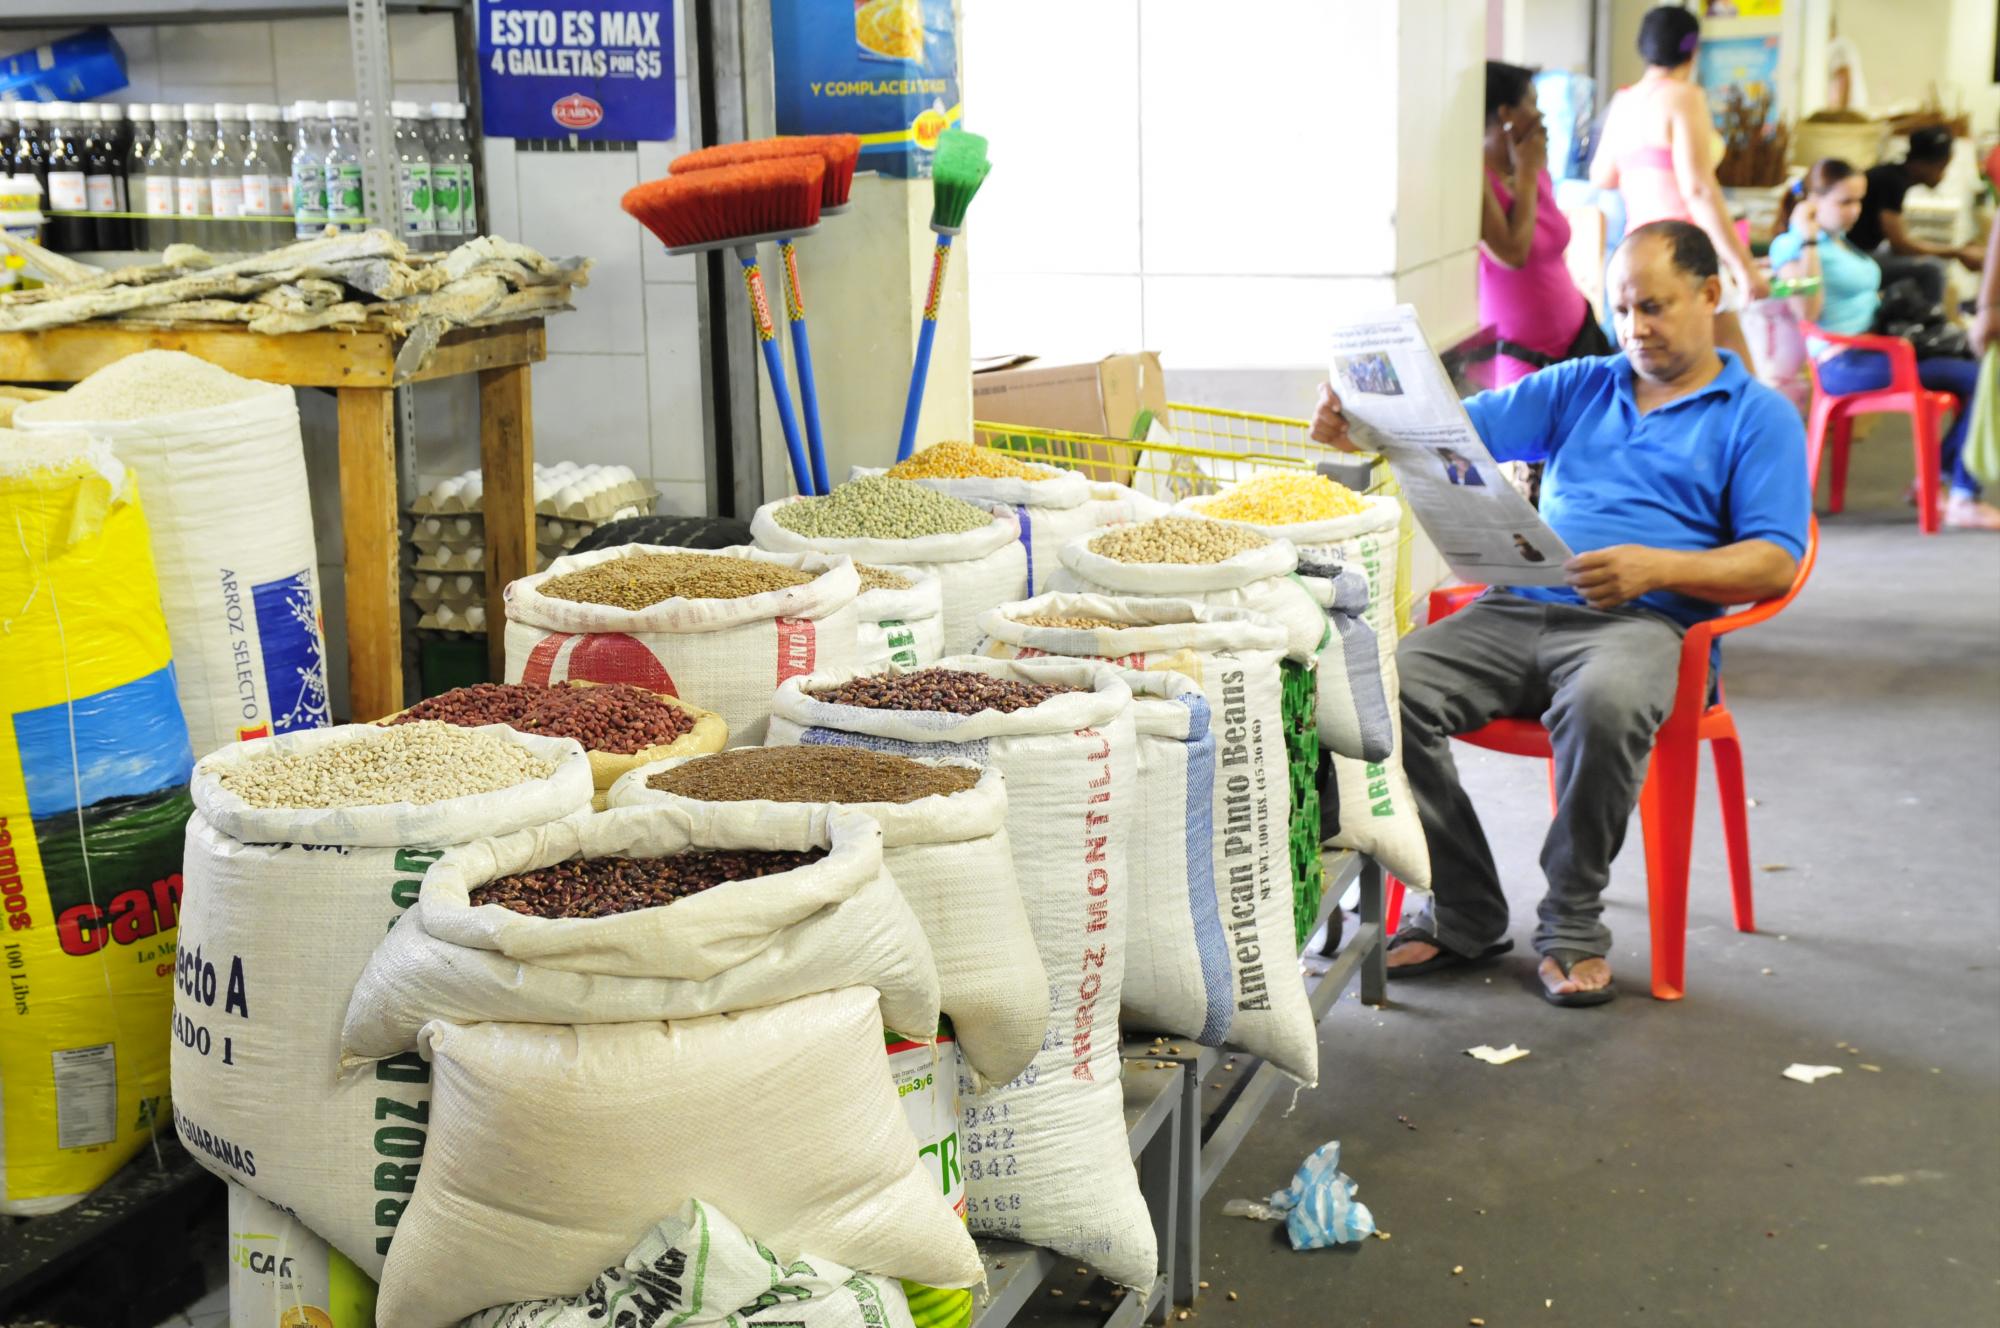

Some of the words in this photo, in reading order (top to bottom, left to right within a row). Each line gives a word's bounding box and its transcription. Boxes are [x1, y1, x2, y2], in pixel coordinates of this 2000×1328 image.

[490, 9, 557, 46] ESTO
[562, 11, 596, 47] ES
[600, 11, 661, 47] MAX
[491, 48, 505, 75] 4
[507, 49, 607, 78] GALLETAS
[610, 56, 634, 72] POR
[636, 48, 662, 80] $5
[811, 82, 822, 97] Y
[825, 79, 908, 97] COMPLACE
[220, 568, 244, 635] ARROZ
[232, 639, 258, 720] SELECTO
[788, 633, 808, 669] AND
[1221, 670, 1249, 770] Beans
[1250, 718, 1263, 743] KG)
[1254, 744, 1268, 793] (45.36
[1224, 774, 1252, 858] Pinto
[1257, 793, 1270, 824] LBS.
[1258, 825, 1270, 847] 100
[1259, 850, 1271, 877] WT.
[1259, 878, 1271, 903] NET
[5, 943, 24, 970] 100
[1228, 863, 1272, 1014] American
[11, 973, 29, 1015] Librs
[225, 955, 248, 1018] A
[1072, 945, 1106, 1082] ARROZ
[182, 1116, 257, 1178] GUARANAS
[374, 1096, 430, 1256] RROZ
